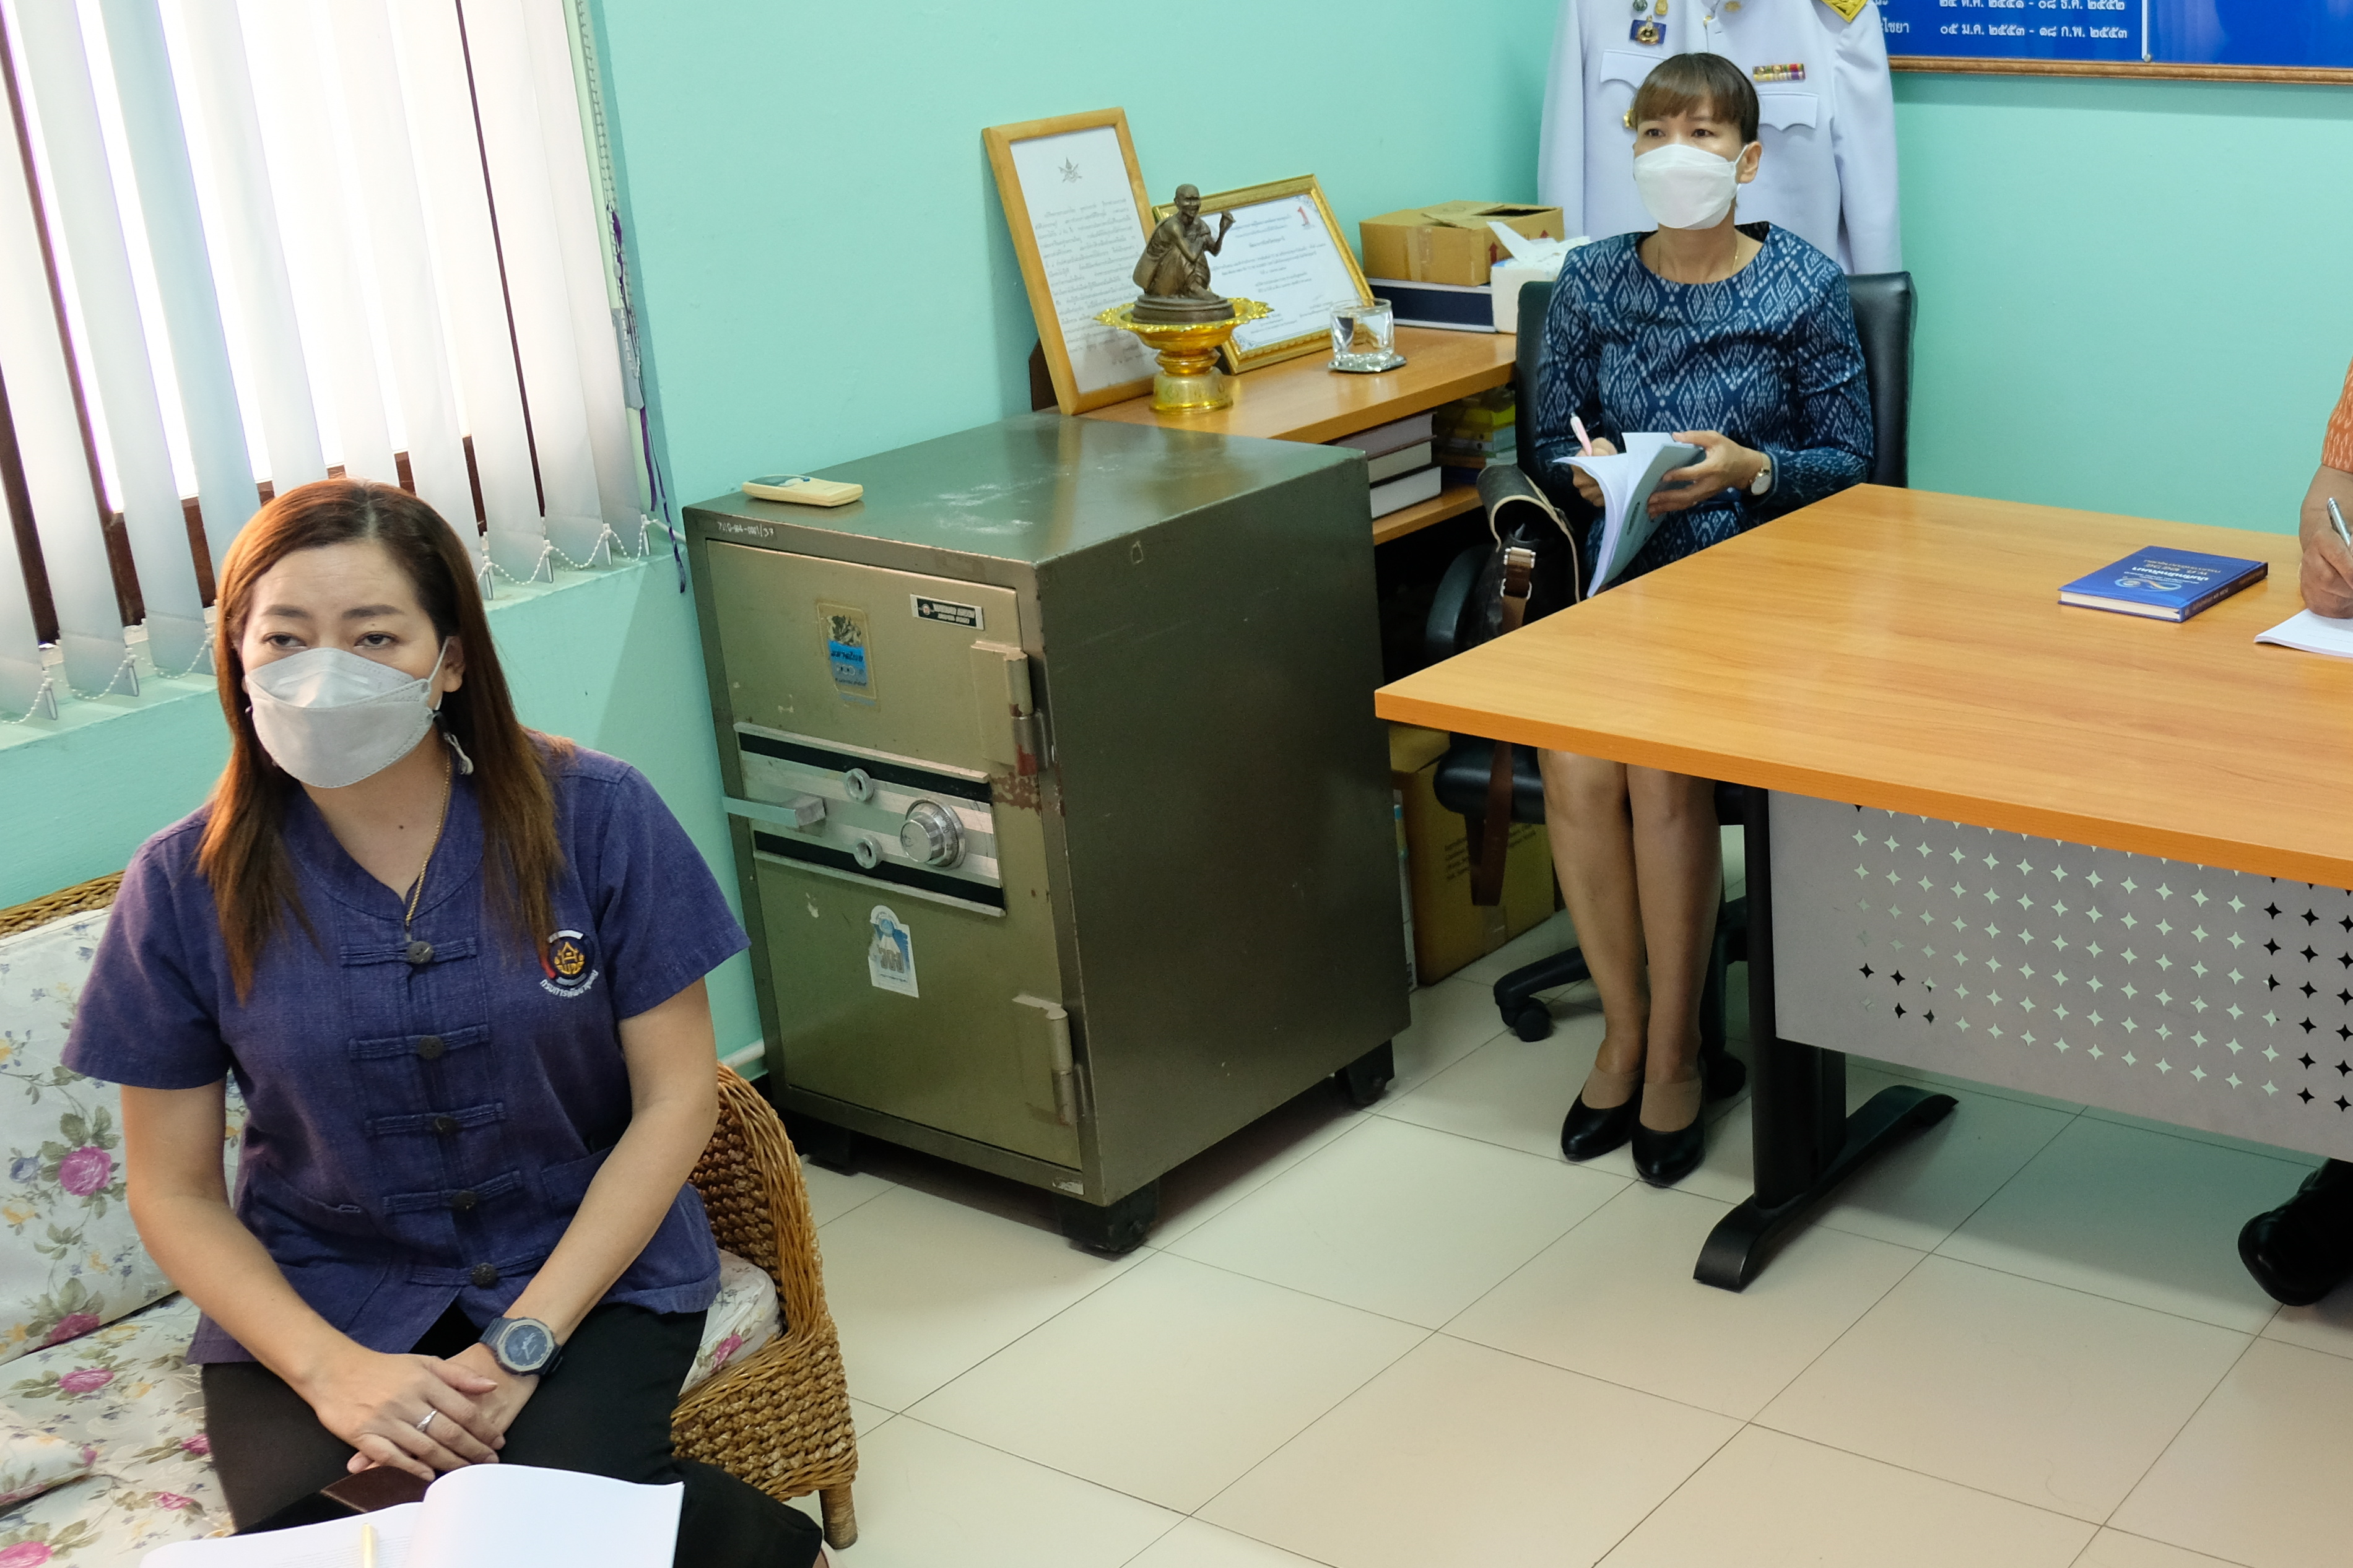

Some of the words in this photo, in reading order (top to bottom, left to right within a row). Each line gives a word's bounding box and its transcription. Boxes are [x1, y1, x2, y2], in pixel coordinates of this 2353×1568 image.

[1961, 24, 1985, 35] ม.ค.
[1988, 24, 2025, 36] ๒๕๕๓
[2039, 26, 2057, 37] ๑๘
[2061, 26, 2086, 38] ก.พ.
[2089, 27, 2128, 38] ๒๕๕๓
[539, 969, 599, 998] กรมการพัฒนาชุมชน
